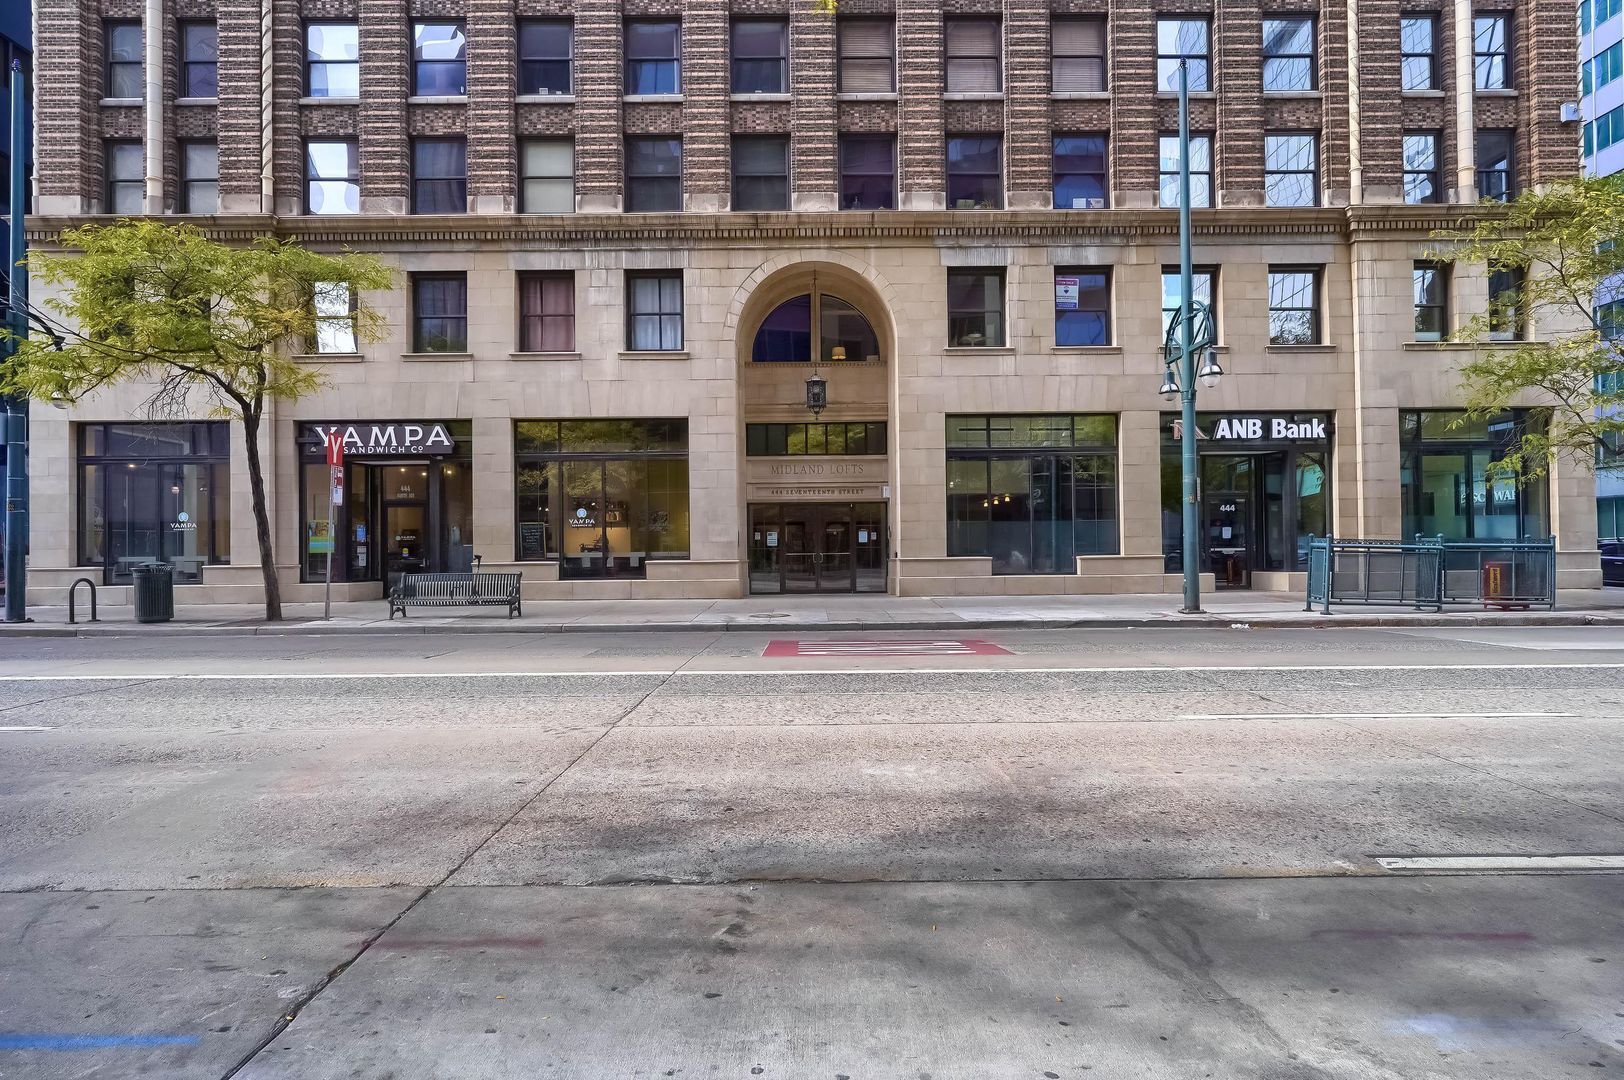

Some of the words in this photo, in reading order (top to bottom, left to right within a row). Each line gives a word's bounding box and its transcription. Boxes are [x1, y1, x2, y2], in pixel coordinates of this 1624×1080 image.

[1215, 418, 1263, 439] ANB
[1271, 418, 1326, 439] Bank
[315, 425, 451, 447] YAMPA
[343, 446, 405, 454] SANDWICH
[771, 464, 824, 475] MIDLAND
[830, 463, 864, 474] LOFTS
[1220, 504, 1235, 512] 444
